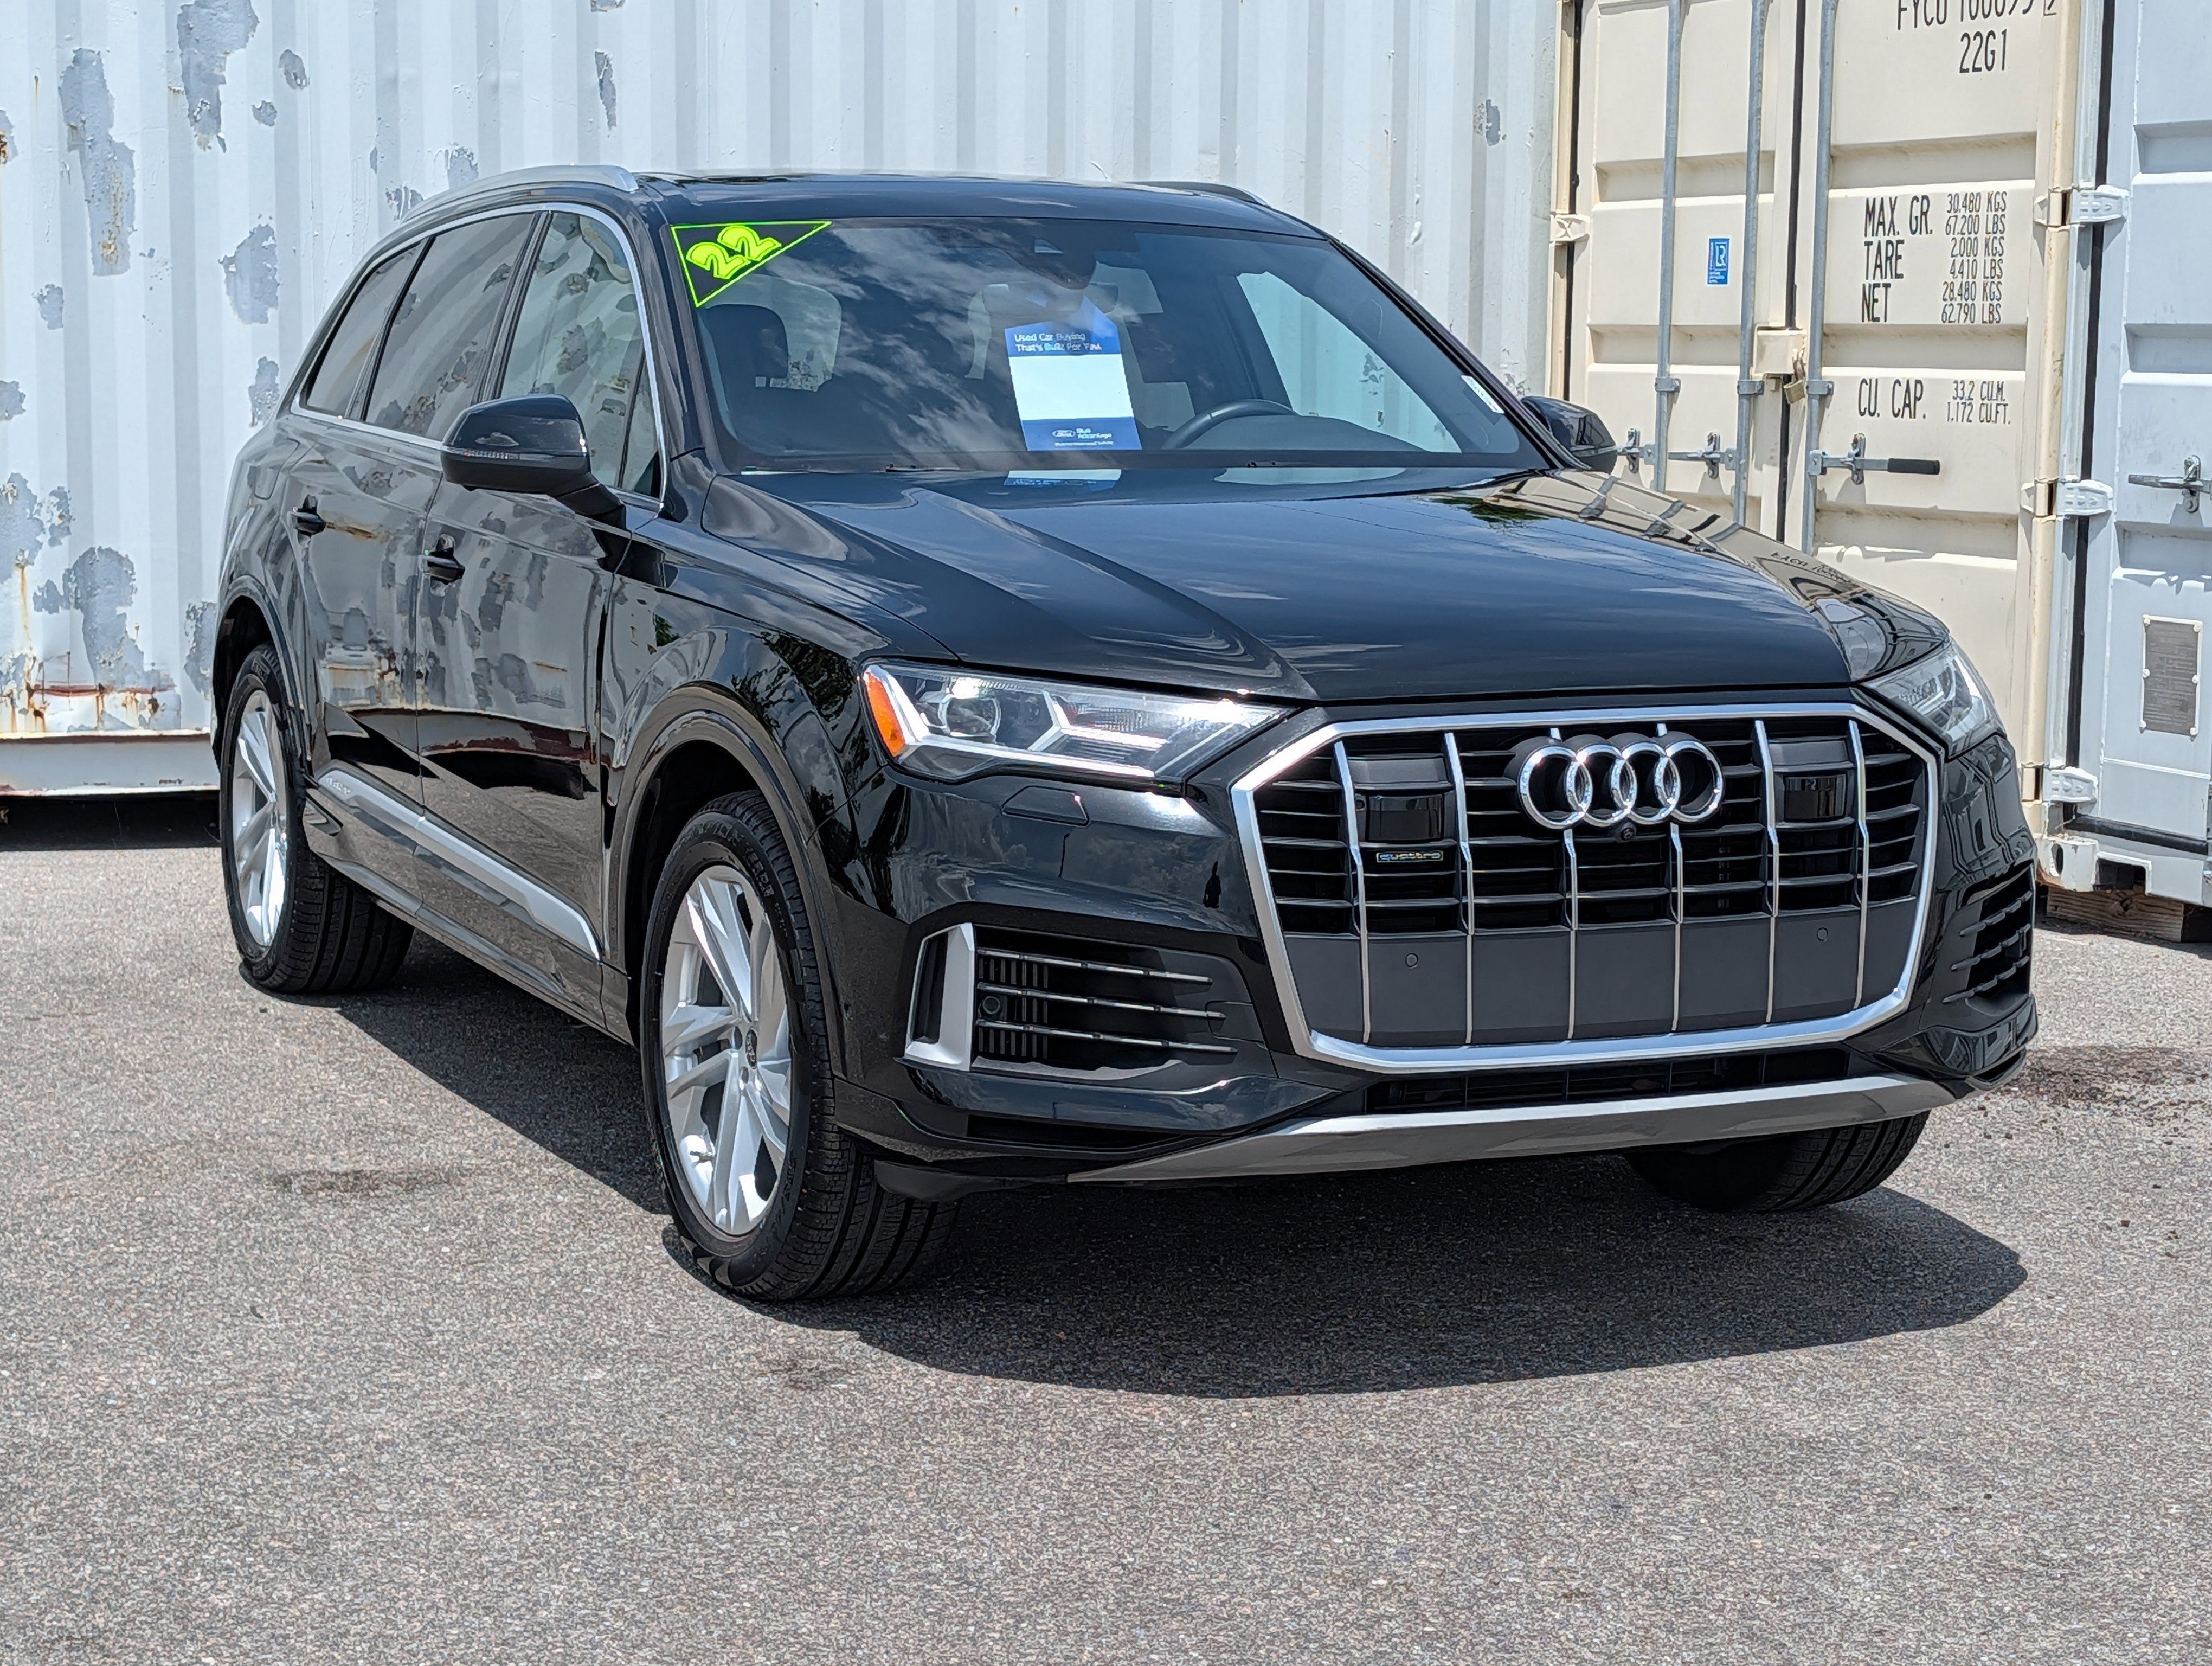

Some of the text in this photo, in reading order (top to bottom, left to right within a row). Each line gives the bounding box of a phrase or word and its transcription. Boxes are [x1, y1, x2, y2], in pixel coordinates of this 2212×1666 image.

[1959, 29, 2007, 73] 22G1
[1864, 196, 1900, 238] MAX.
[1909, 194, 1933, 235] GR.
[1986, 191, 2008, 212] KGS
[1985, 214, 2005, 234] LBS
[686, 225, 782, 279] 22
[1864, 239, 1905, 280] TARE
[1984, 236, 2005, 257] KGS
[1983, 258, 2003, 279] LBS
[1862, 283, 1891, 323] NET
[1982, 280, 2002, 302] KGS
[1982, 303, 2001, 324] LBS
[1858, 378, 1880, 418] CU.
[1891, 379, 1926, 419] CAP.
